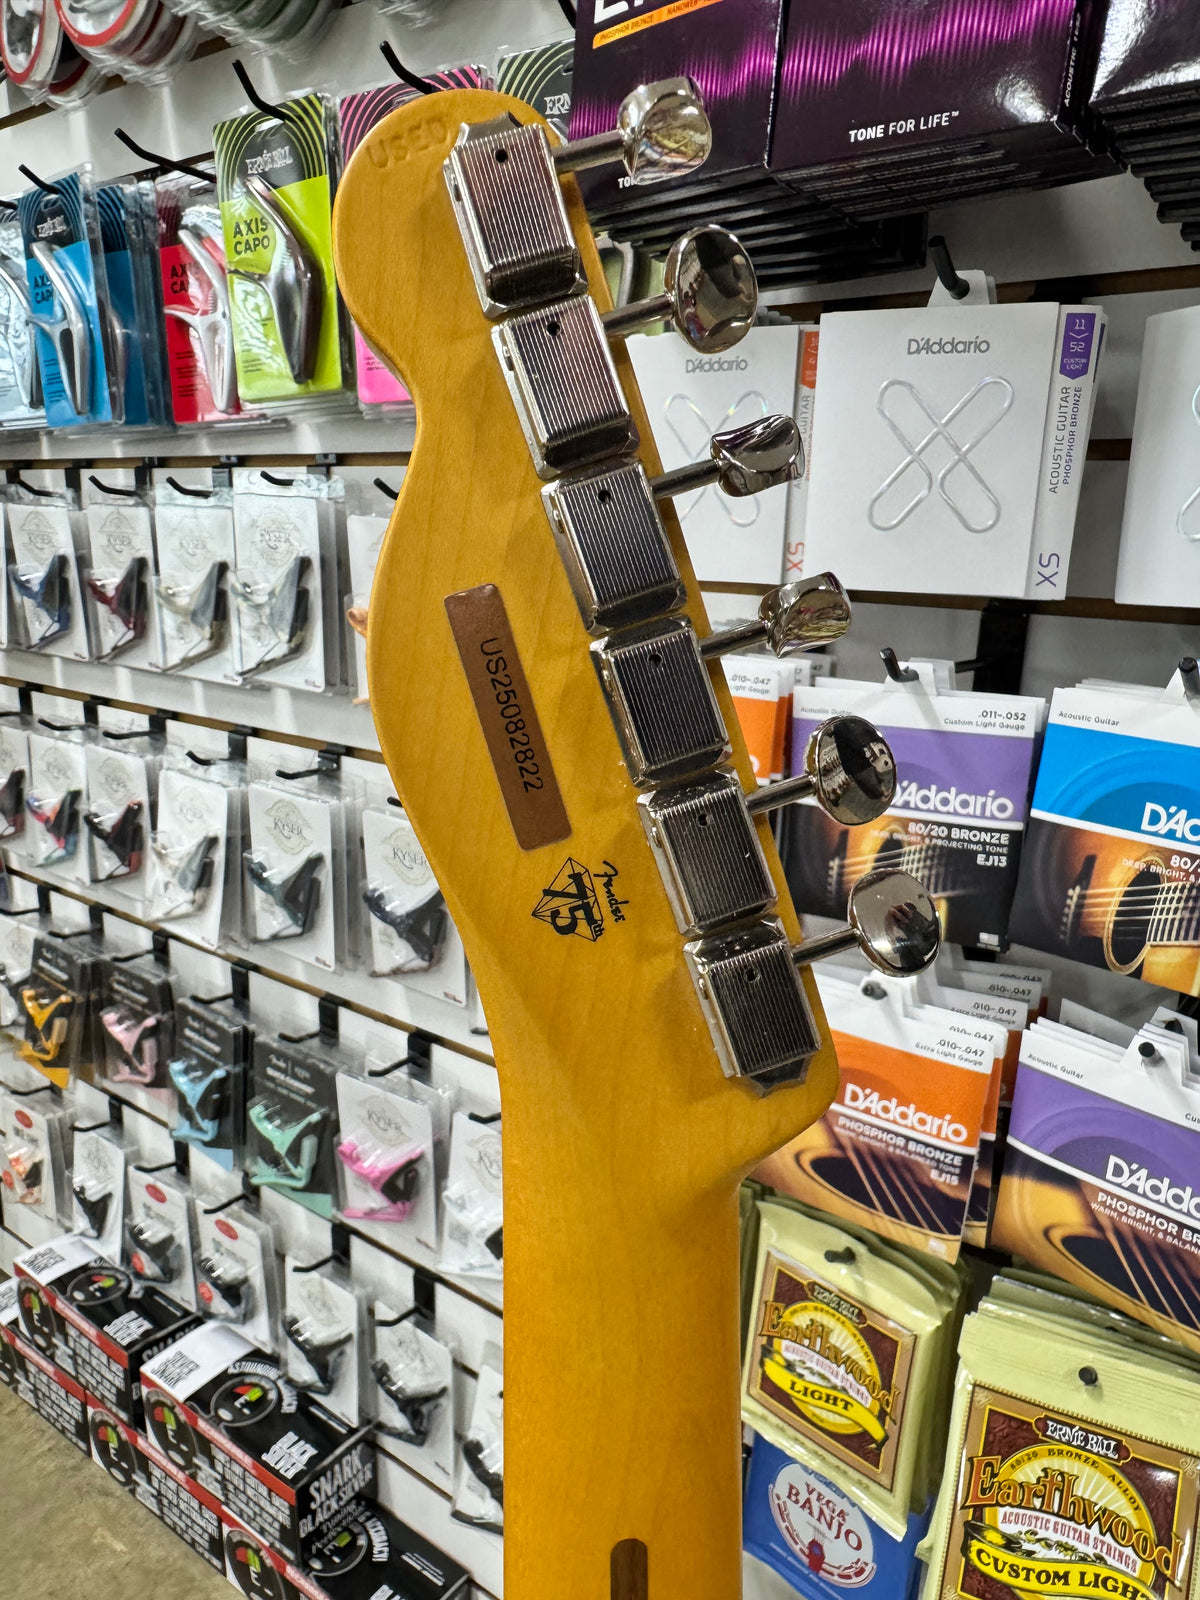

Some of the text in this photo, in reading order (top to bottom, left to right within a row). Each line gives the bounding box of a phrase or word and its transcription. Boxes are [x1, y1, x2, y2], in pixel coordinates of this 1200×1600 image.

[1064, 46, 1077, 107] ACOUSTIC
[849, 125, 885, 143] TONE
[889, 119, 915, 135] FOR
[233, 216, 269, 238] AXIS
[233, 237, 270, 255] CAPO
[1074, 319, 1086, 330] 11
[685, 356, 748, 374] D'Addario
[907, 337, 990, 355] D'Addario
[1070, 341, 1085, 352] 52
[1048, 386, 1072, 494] ACOUSTIC GUITAR
[1062, 386, 1082, 485] PHOSPHOR BRONZE
[786, 542, 805, 572] XS
[1035, 552, 1060, 587] XS
[480, 637, 544, 793] US25082822
[944, 717, 1025, 731] Custom Light Gauge
[1058, 710, 1120, 727] Acoustic Guitar
[892, 780, 1014, 818] 'Addario
[908, 822, 948, 837] 80/20
[951, 827, 1010, 845] BRONZE
[985, 845, 1009, 854] TONE
[976, 853, 1008, 868] EJ13
[1170, 854, 1200, 873] 80/
[593, 860, 629, 923] Fender
[843, 1082, 968, 1143] D'Addario
[838, 1115, 906, 1147] PHOSPHOR
[907, 1140, 963, 1167] BRONZE
[1090, 1201, 1120, 1221] WARM,
[1121, 1215, 1155, 1236] BRIGHT,
[1097, 1191, 1179, 1235] PHOSPHOR
[759, 1301, 901, 1425] Earthwood
[789, 1379, 854, 1411] LIGHT
[1046, 1420, 1120, 1459] ERNIE BALL
[309, 1443, 363, 1510] SNARK
[1048, 1448, 1100, 1468] BRONZE
[1108, 1473, 1142, 1512] ALLOY
[786, 1482, 863, 1551] BANJO
[805, 1481, 849, 1525] VEGA
[960, 1455, 1186, 1592] Earthwood
[1001, 1510, 1138, 1573] ACOUSTIC GUITAR STRINGS
[976, 1548, 1071, 1587] CUSTOM
